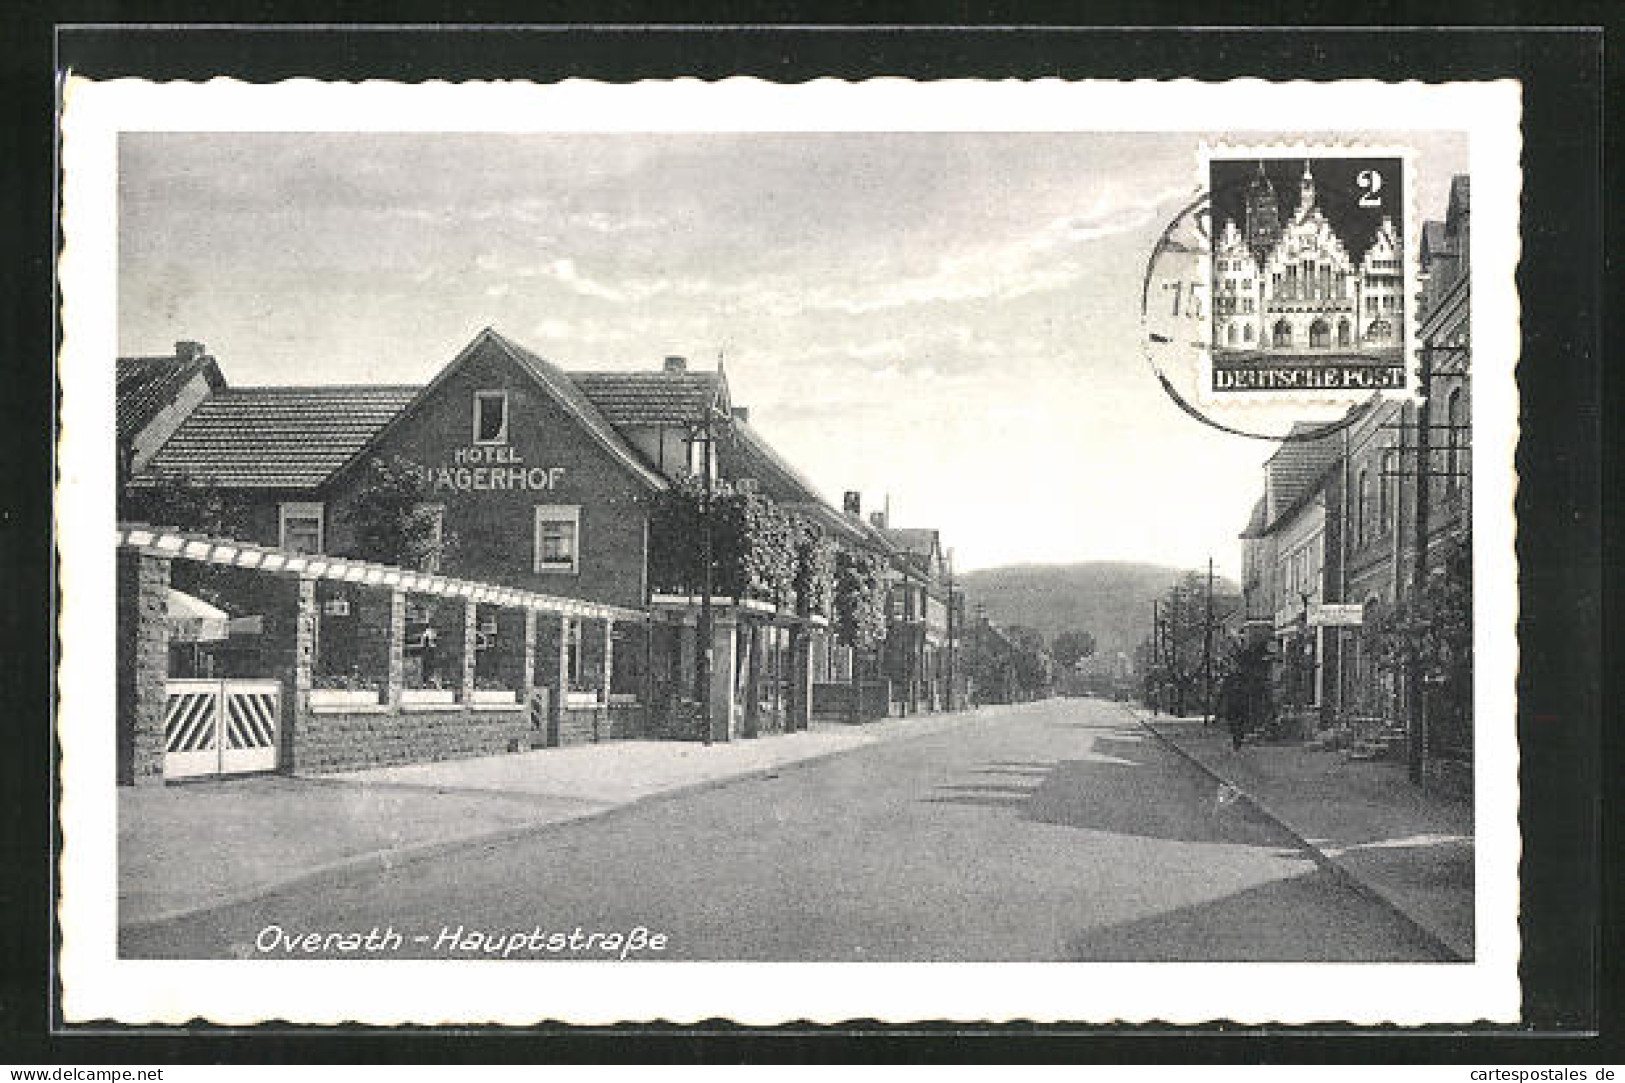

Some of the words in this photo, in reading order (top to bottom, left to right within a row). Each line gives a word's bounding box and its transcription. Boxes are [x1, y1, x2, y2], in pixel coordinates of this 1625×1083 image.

[1356, 170, 1382, 206] 2
[1216, 368, 1338, 387] DEUTSCHE
[1342, 367, 1404, 387] POST
[454, 447, 523, 463] HOTEL
